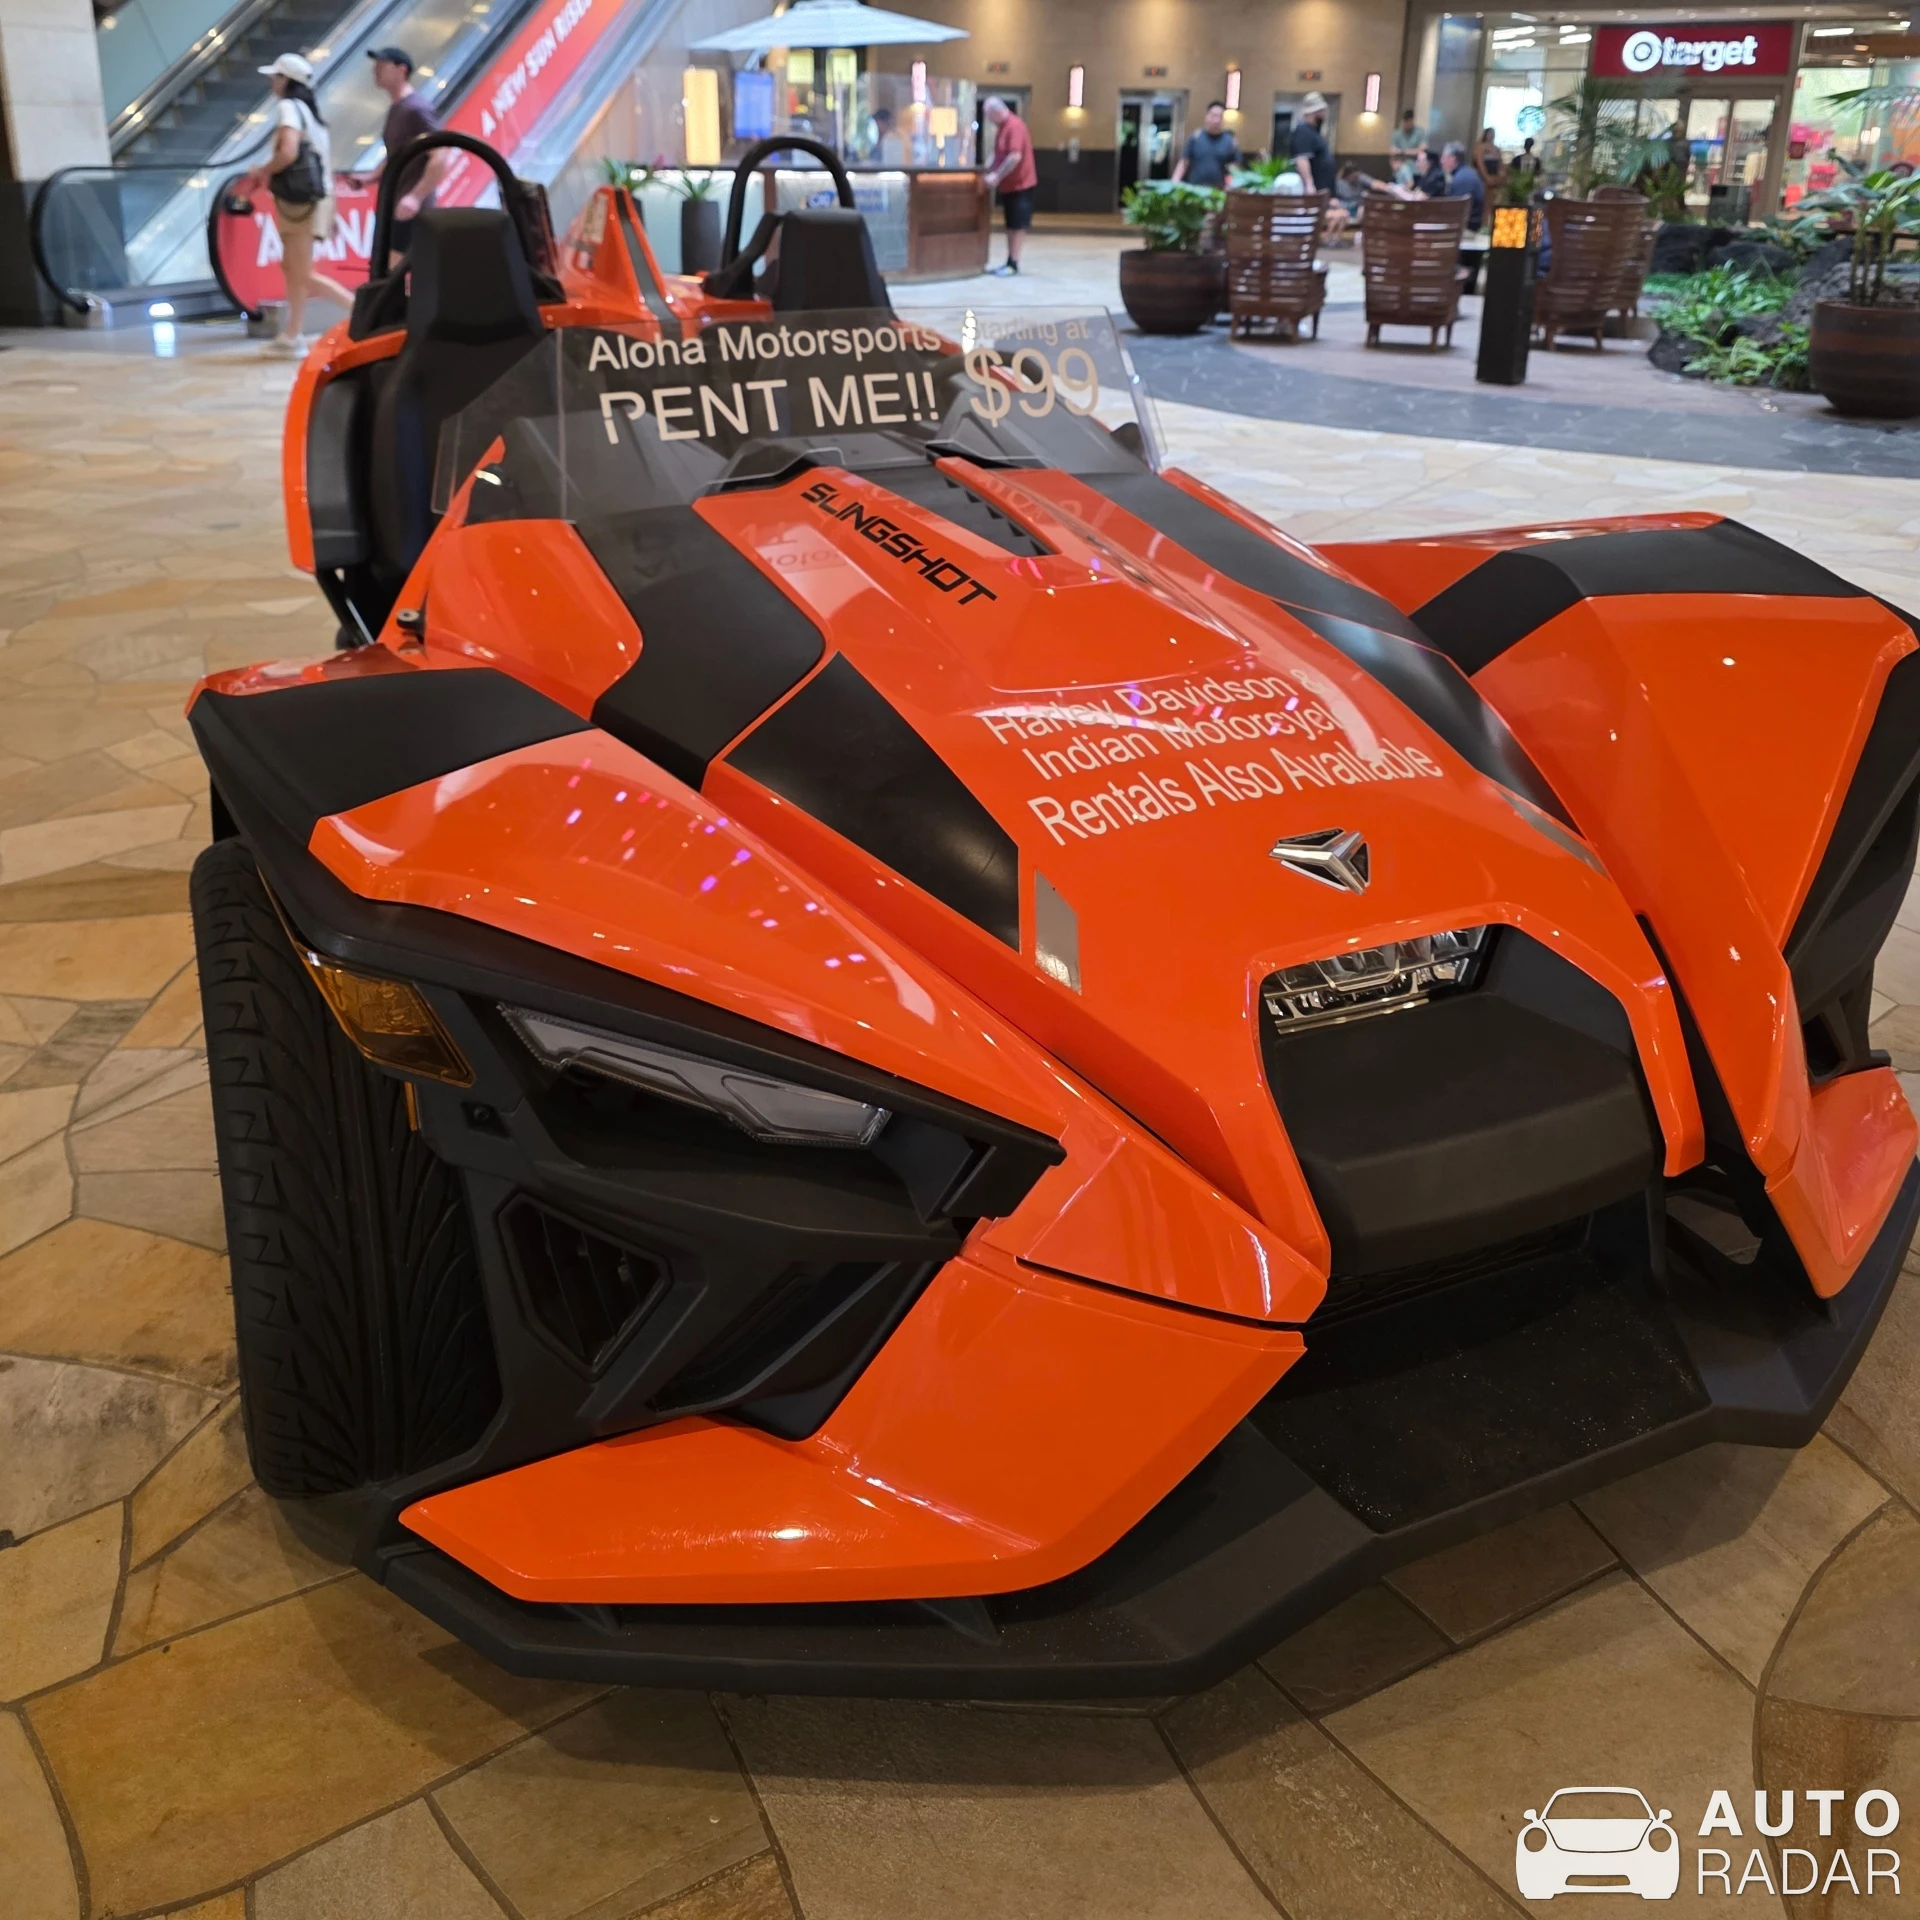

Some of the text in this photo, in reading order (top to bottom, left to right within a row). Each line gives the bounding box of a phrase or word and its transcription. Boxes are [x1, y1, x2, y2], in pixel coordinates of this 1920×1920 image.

[1661, 35, 1758, 72] target
[490, 62, 527, 121] NEW
[588, 325, 942, 372] Aloha Motorsports
[807, 371, 939, 428] ME!!
[965, 345, 1099, 428] $99
[800, 482, 998, 605] SLINGSHOT
[981, 699, 1120, 745] Harley
[1114, 676, 1299, 716] Davidson
[1022, 732, 1160, 780] Indian
[1027, 737, 1444, 846] Rentals Also Available
